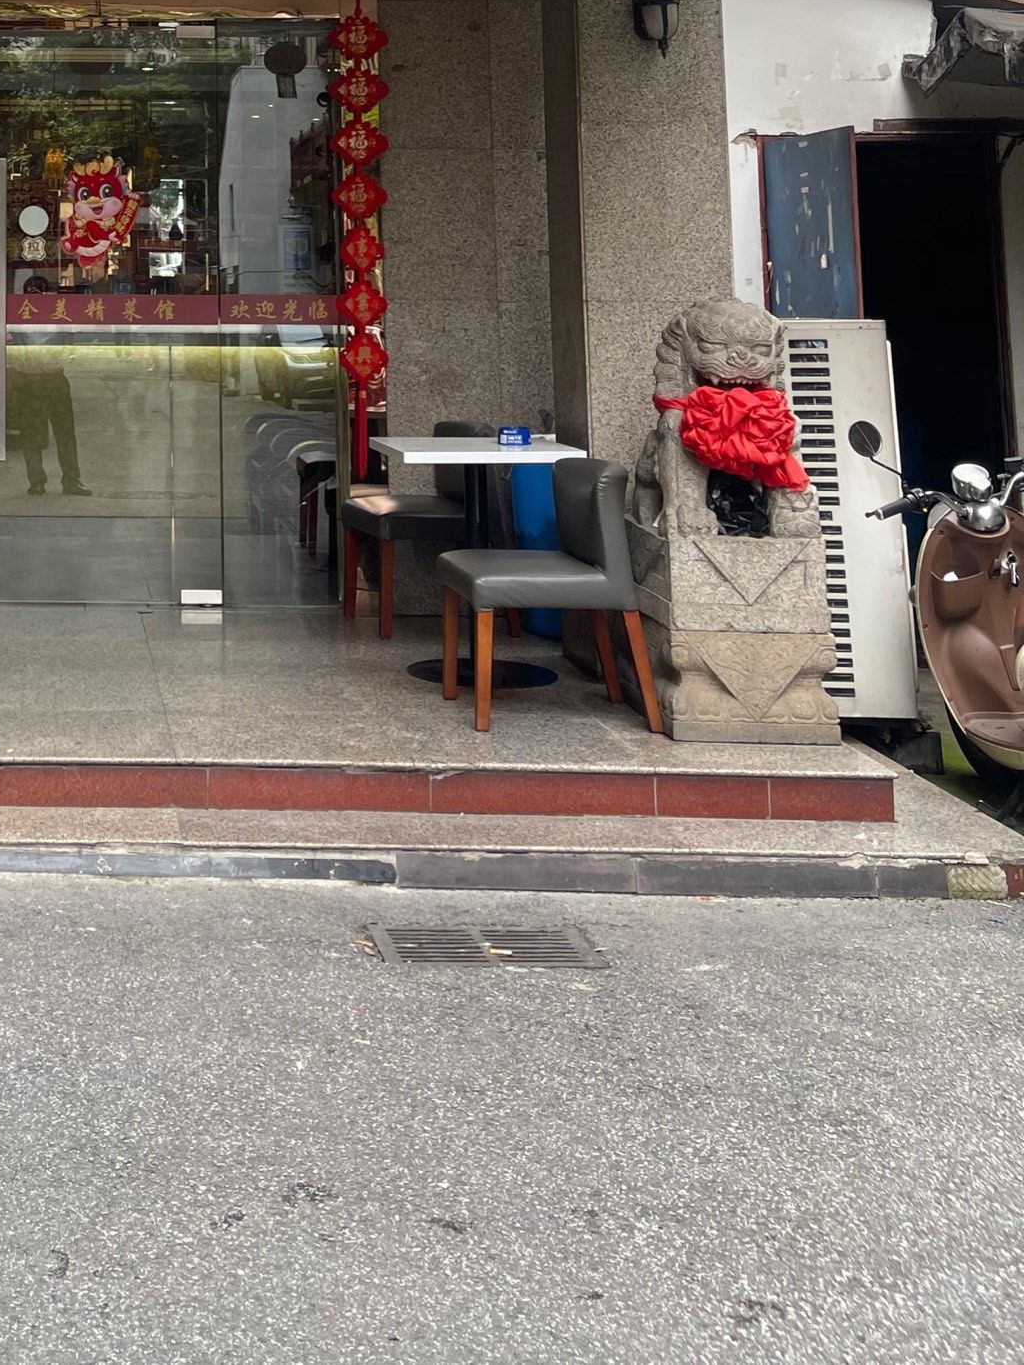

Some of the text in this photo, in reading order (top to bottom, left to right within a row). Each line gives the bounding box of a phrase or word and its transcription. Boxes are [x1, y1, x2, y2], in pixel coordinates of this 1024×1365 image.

[17, 299, 177, 322] 全美精菜馆
[229, 299, 329, 323] 欢迎光临
